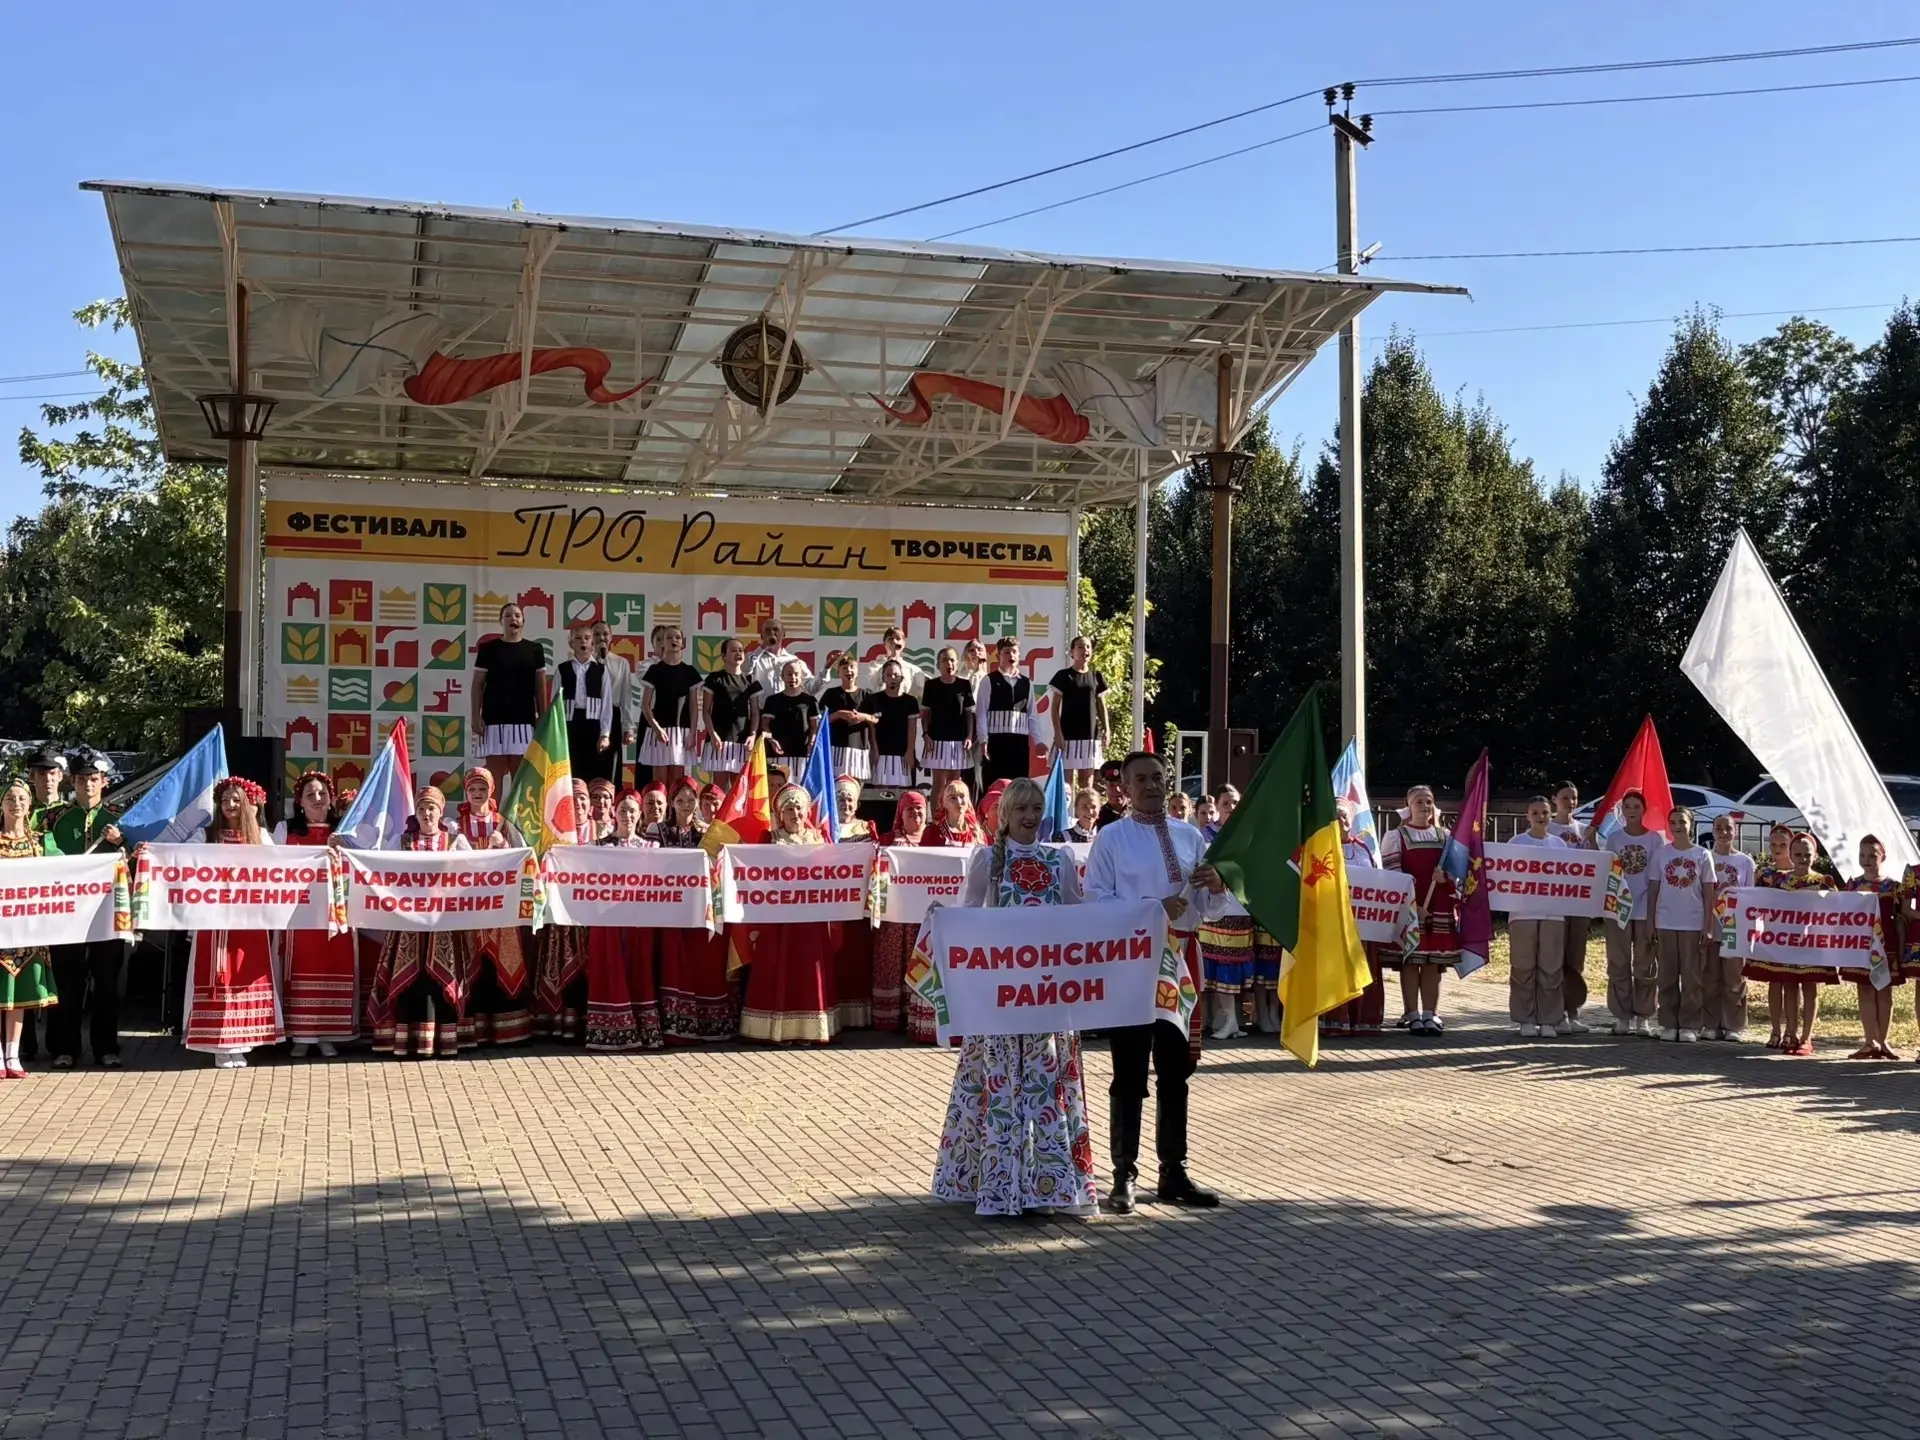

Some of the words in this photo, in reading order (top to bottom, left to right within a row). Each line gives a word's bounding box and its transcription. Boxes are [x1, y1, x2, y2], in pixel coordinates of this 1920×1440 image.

[287, 511, 467, 539] ФЕСТИВАЛЬ
[496, 503, 647, 564] ПРО.
[670, 510, 888, 570] Район
[890, 538, 1053, 562] ТВОРЧЕСТВА
[151, 866, 329, 883] ГОРОЖАНСКОЕ
[354, 869, 518, 888] КАРАЧУНСКОЕ
[547, 871, 709, 888] КОМСОМОЛЬСКОЕ
[733, 864, 864, 882] ЛОМОВСКОЕ
[168, 888, 311, 904] ПОСЕЛЕНИЕ
[365, 895, 504, 912] ПОСЕЛЕНИЕ
[572, 888, 683, 903] ПОСЕЛЕНИЕ
[736, 887, 861, 905] ПОСЕЛЕНИЕ
[0, 901, 76, 918] ЕЛЕНИЕ
[1747, 929, 1872, 950] ПОСЕЛЕНИЕ
[948, 928, 1152, 970] РАМОНСКИЙ
[996, 974, 1105, 1008] РАЙОН
